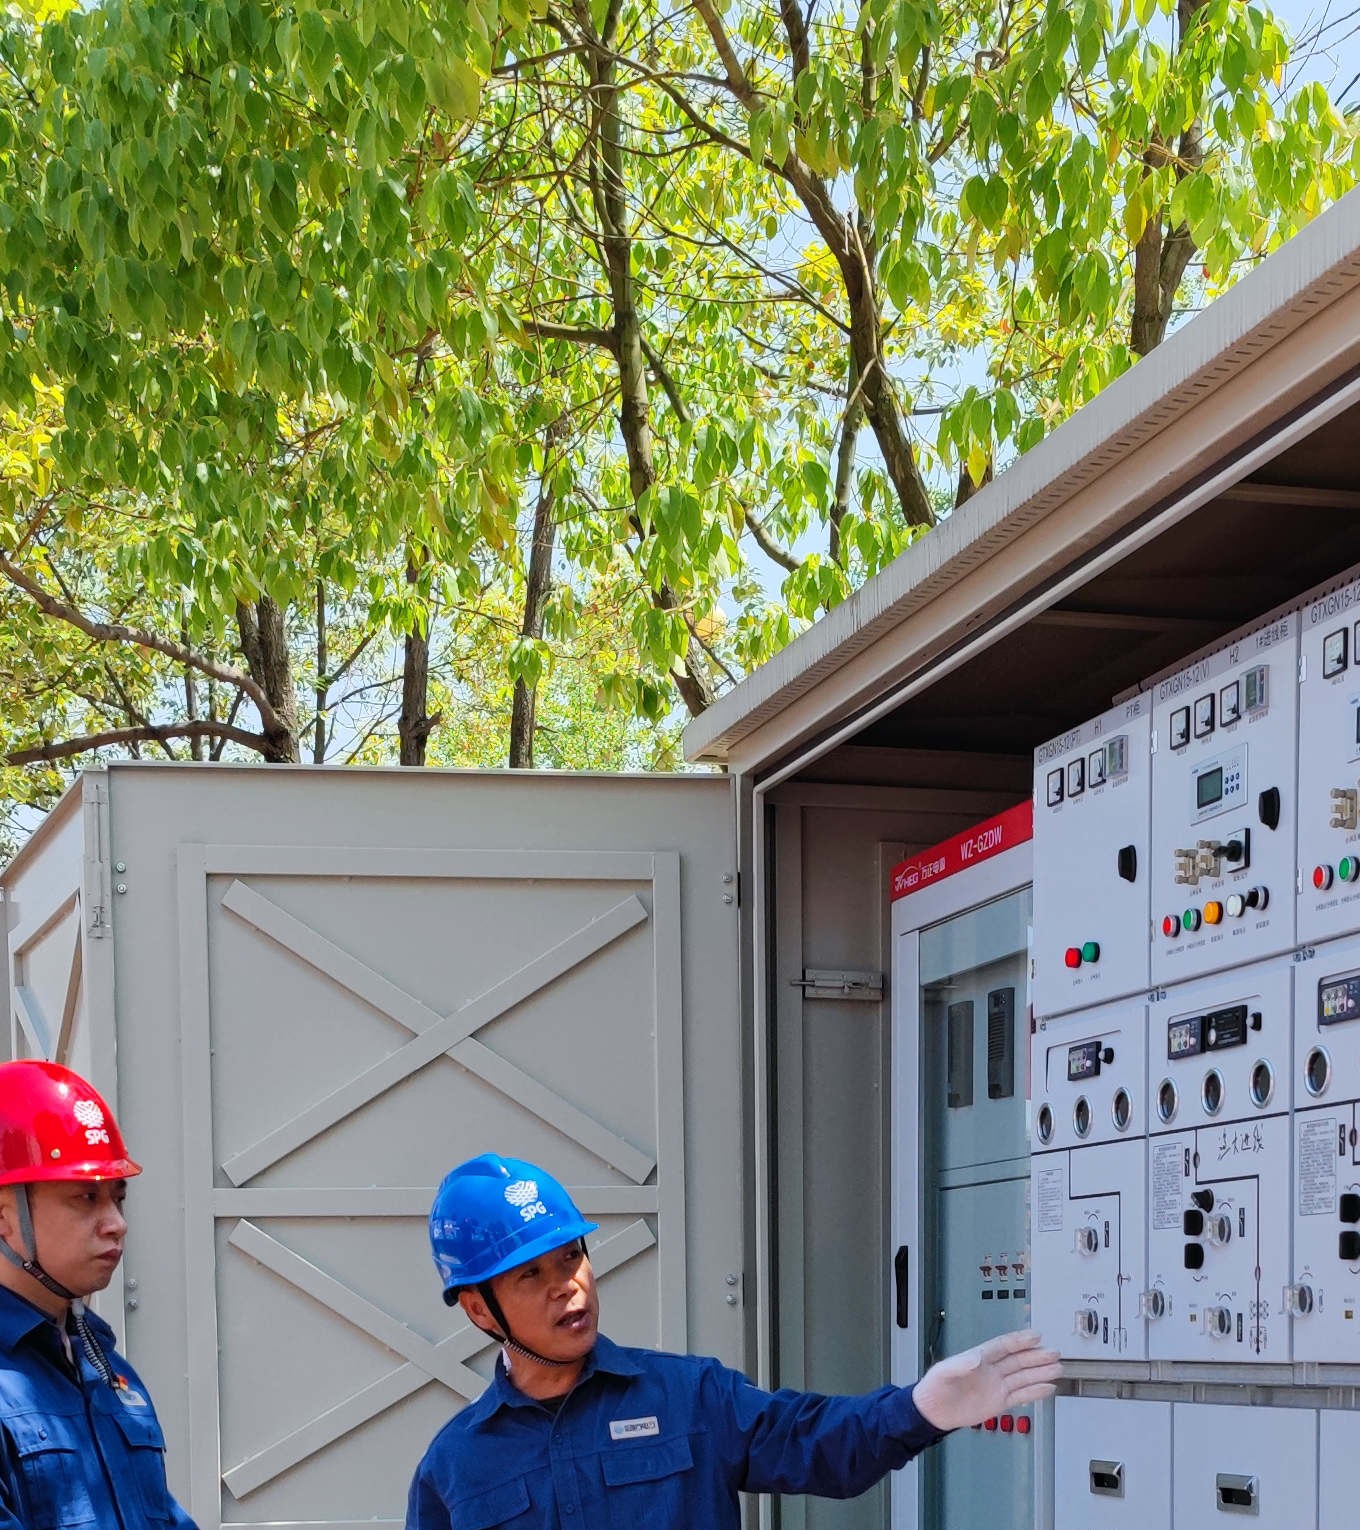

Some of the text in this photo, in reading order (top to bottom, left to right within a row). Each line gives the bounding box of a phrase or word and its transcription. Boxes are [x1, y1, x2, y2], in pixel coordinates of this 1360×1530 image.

[1229, 646, 1239, 665] H2
[960, 825, 1003, 861] WZ-GZDW
[85, 1129, 110, 1145] SPG
[520, 1200, 547, 1223] SPG
